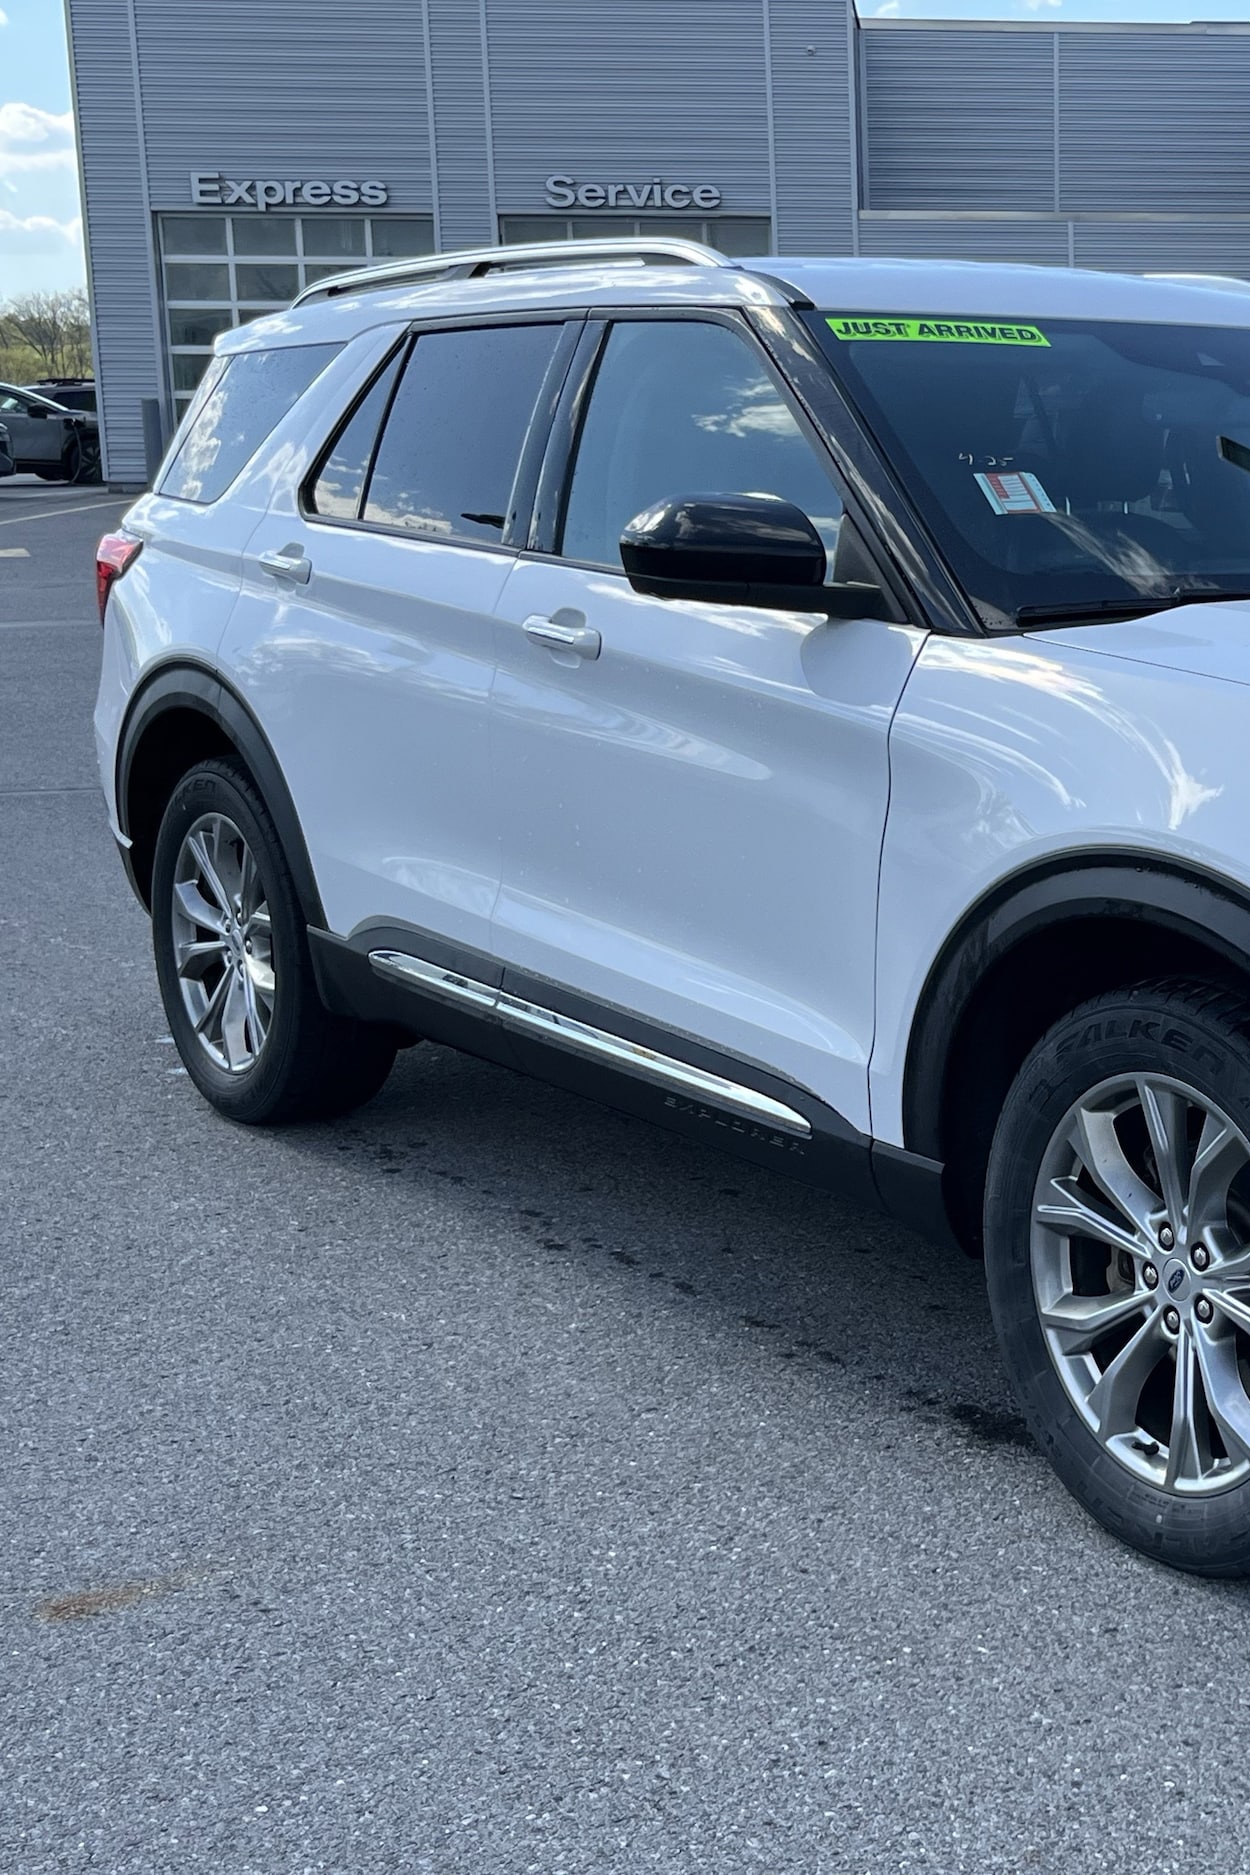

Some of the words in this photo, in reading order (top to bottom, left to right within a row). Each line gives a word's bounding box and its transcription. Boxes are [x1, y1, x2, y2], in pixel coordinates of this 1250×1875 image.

[190, 171, 388, 212] Express
[545, 175, 721, 209] Service
[836, 321, 909, 337] JUST
[918, 322, 1042, 342] ARRIVED
